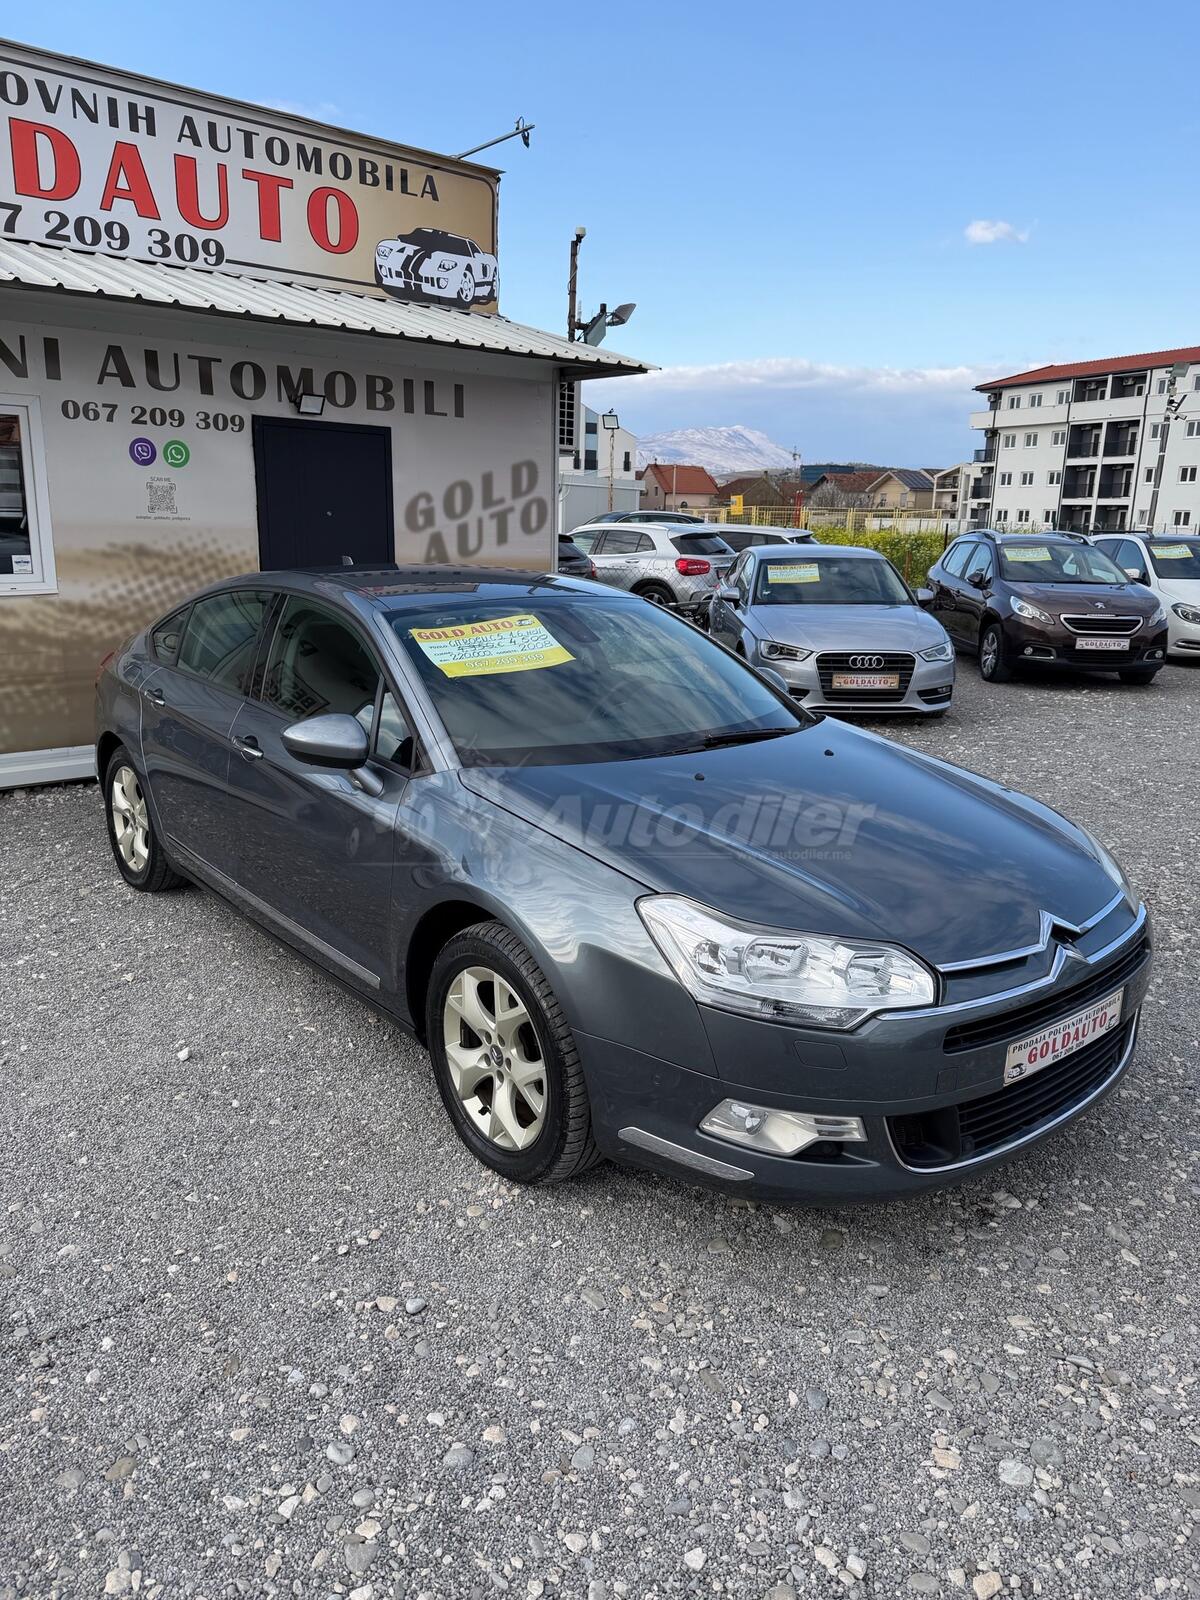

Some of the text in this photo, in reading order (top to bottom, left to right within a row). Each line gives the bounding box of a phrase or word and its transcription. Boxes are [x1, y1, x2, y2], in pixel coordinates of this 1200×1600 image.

[0, 70, 439, 202] OVNIH AUTOMOBILA
[8, 116, 359, 255] DAUTO
[43, 210, 130, 251] 209
[147, 228, 225, 267] 309
[97, 344, 464, 418] AUTOMOBILI
[61, 399, 245, 432] 067 209 309
[404, 459, 538, 533] GOLD
[423, 496, 549, 563] AUTO
[416, 620, 514, 641] GOLD AUTO
[1012, 1034, 1046, 1054] PRODAJA
[1048, 1017, 1083, 1039] POLOVNIH
[1027, 1011, 1108, 1065] GOLDAUTO
